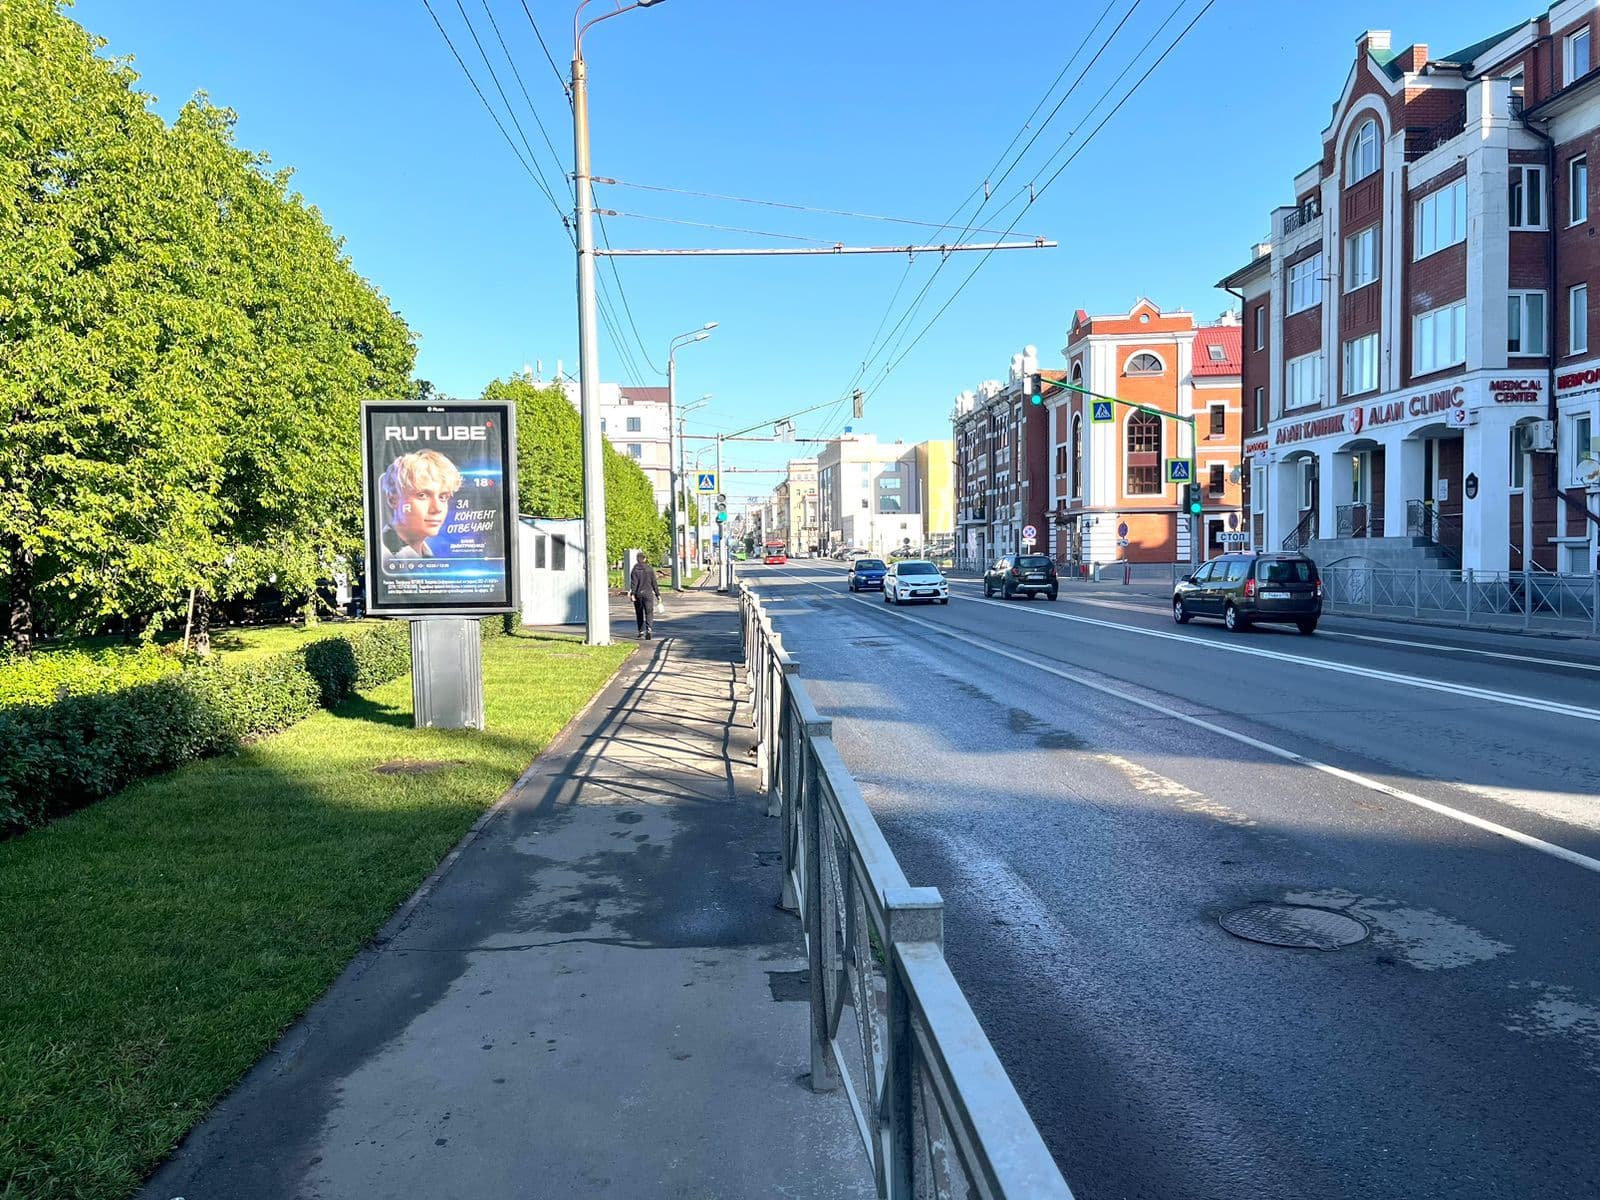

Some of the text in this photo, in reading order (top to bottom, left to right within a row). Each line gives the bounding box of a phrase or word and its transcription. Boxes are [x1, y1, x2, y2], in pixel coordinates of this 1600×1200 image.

[1489, 380, 1542, 391] MEDICAL
[1494, 392, 1538, 403] CENTER
[1368, 386, 1464, 425] ALAN CLINIC
[385, 426, 487, 441] RUTUBE
[1276, 414, 1345, 444] АЛАН КЛИНИК
[402, 503, 412, 513] R
[456, 499, 469, 509] ЗА
[454, 509, 496, 521] КОНТЕНТ
[447, 521, 494, 534] ОТВЕЧАЮ!
[1220, 533, 1245, 541] СТОП
